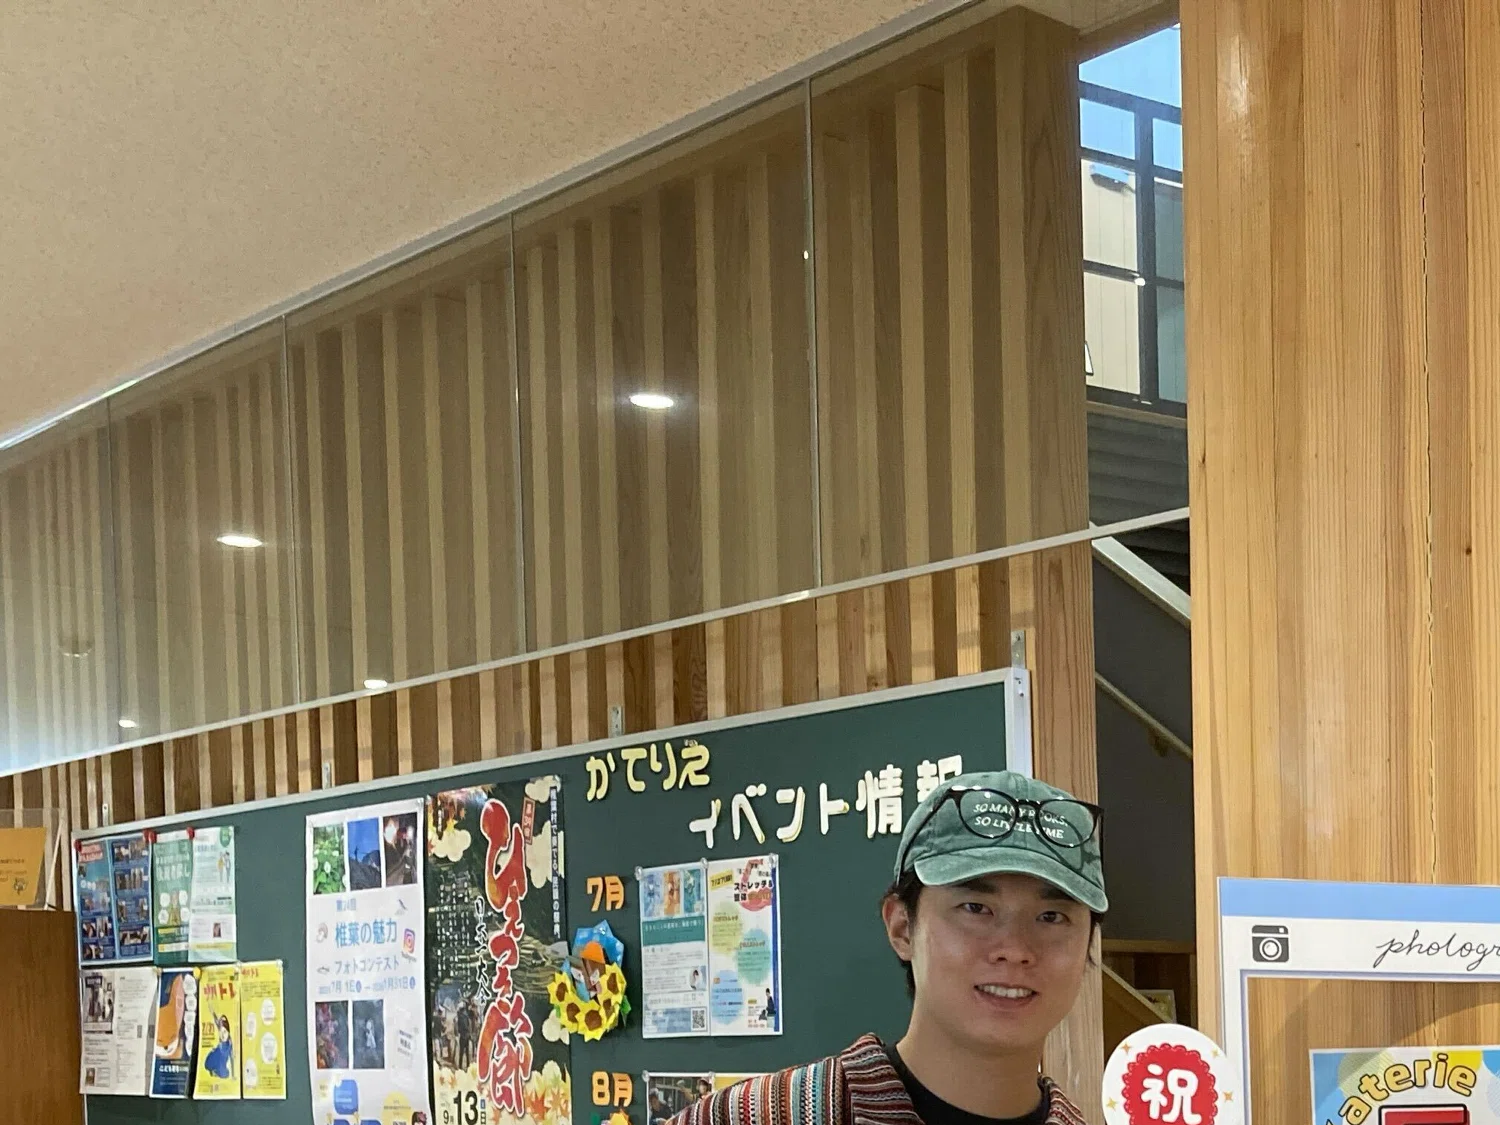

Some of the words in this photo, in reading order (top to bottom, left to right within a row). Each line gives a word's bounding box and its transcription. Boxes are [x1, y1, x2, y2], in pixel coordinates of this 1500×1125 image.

[585, 741, 710, 801] かてりえ
[688, 754, 962, 849] イベント情報
[973, 803, 988, 812] SO
[974, 816, 991, 826] SO
[587, 875, 625, 912] 7月
[335, 917, 398, 949] 椎葉の魅力
[334, 955, 400, 975] フォトコンテスト
[477, 798, 533, 1118] ひえつき節
[592, 1072, 633, 1106] 8月
[1141, 1063, 1202, 1125] 祝
